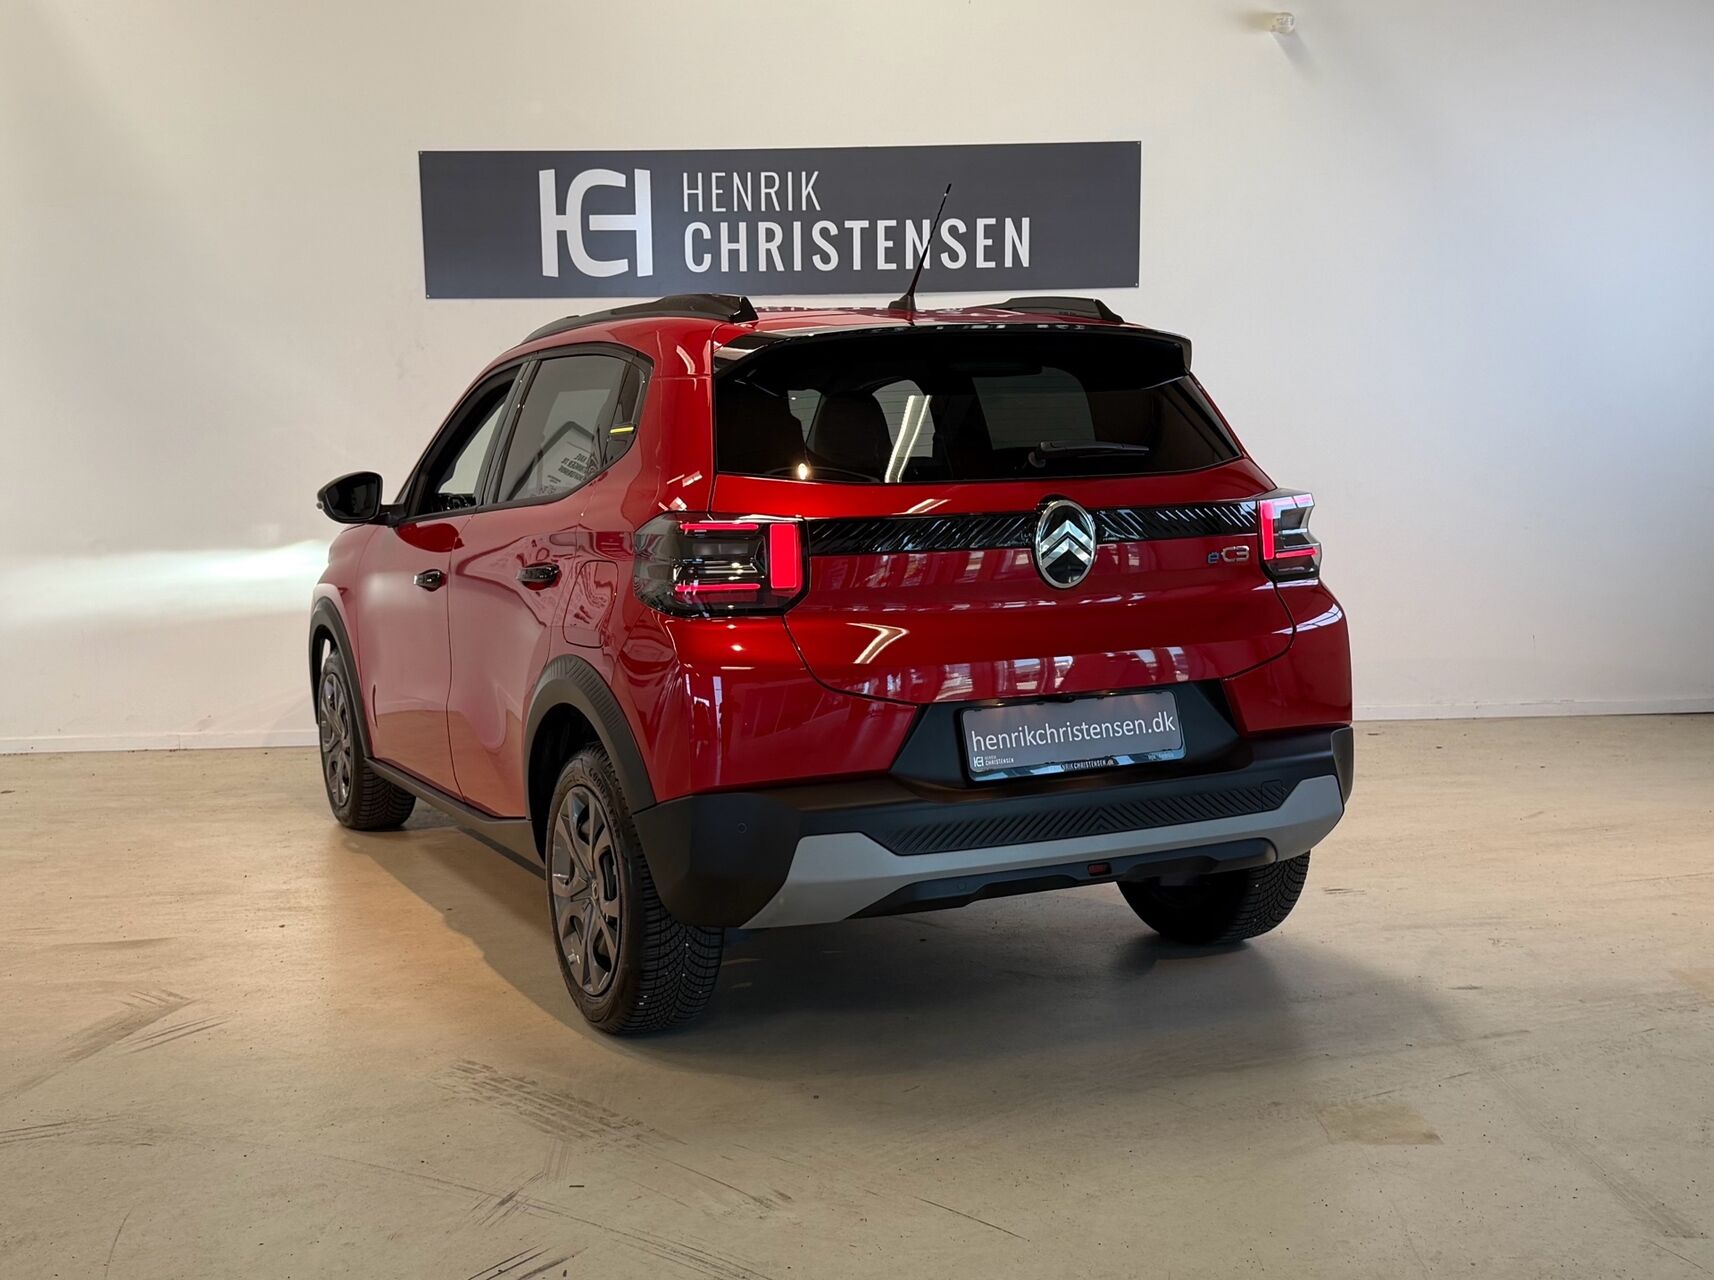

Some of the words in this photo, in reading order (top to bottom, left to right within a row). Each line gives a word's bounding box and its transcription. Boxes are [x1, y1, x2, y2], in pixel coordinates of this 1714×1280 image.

[682, 171, 822, 213] HENRIK
[683, 216, 1032, 274] CHRISTENSEN
[971, 711, 1176, 752] henrikchristensen.dk
[985, 757, 1014, 766] CHRISTENSEN
